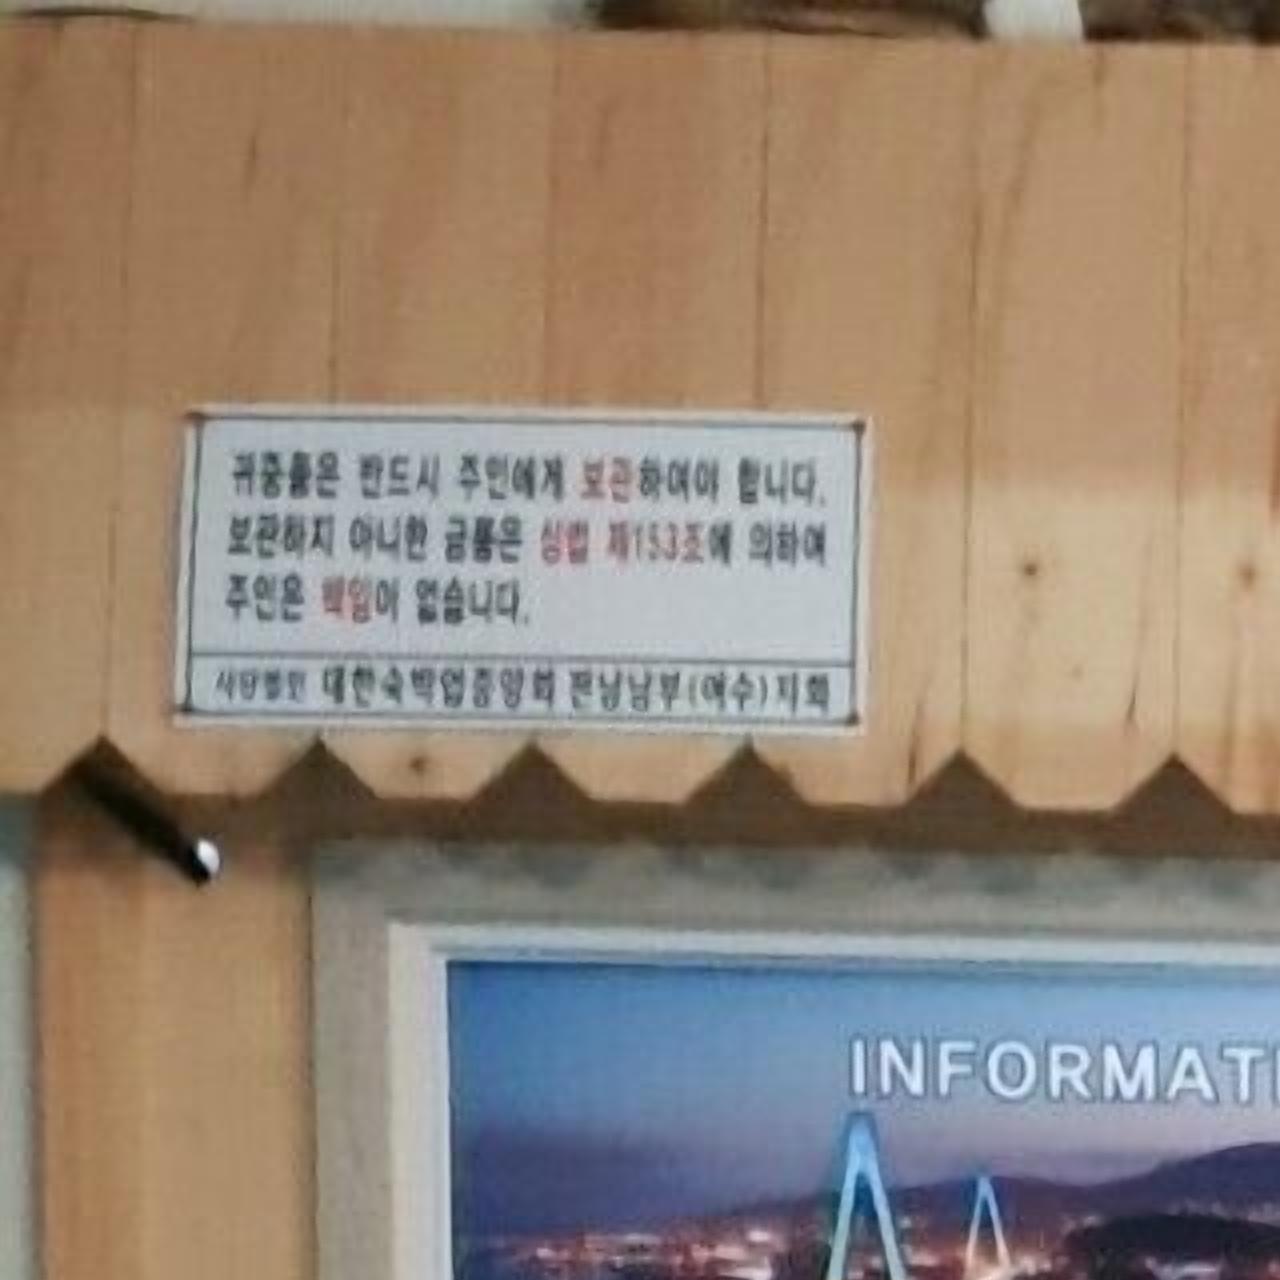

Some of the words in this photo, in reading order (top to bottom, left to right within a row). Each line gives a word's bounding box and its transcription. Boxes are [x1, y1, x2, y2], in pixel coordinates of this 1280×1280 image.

[360, 453, 441, 501] 반드시
[460, 453, 563, 502] 주인에게
[228, 514, 334, 560] 보관하지
[349, 515, 429, 563] 아니한
[748, 520, 827, 568] 의하여
[225, 573, 305, 625] 주인은
